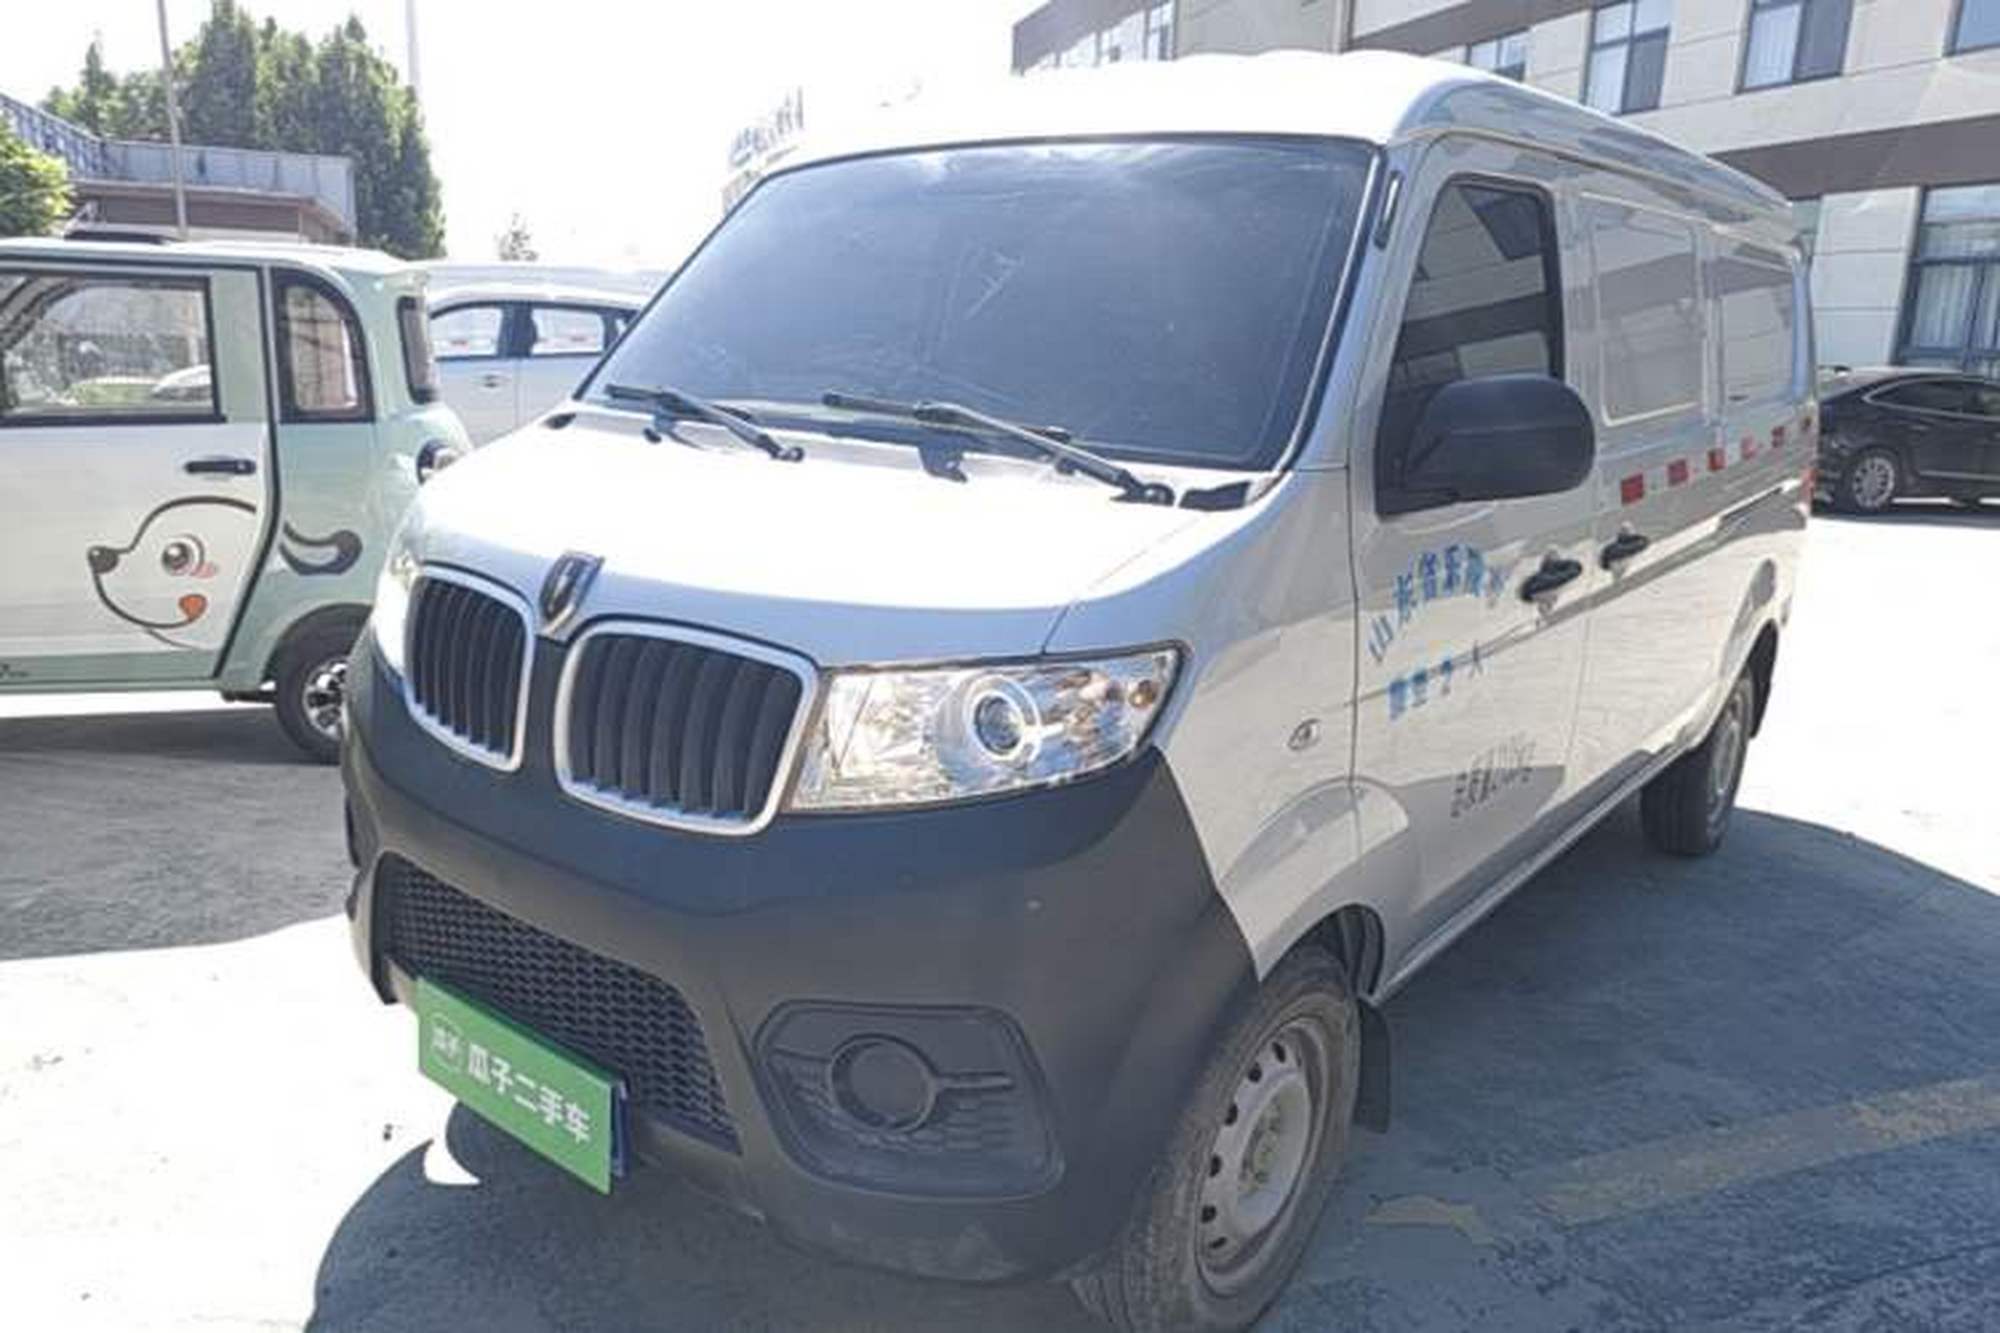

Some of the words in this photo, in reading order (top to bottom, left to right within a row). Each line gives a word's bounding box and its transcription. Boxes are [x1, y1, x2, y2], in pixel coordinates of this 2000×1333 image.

[468, 1040, 591, 1145] 瓜子二手车
